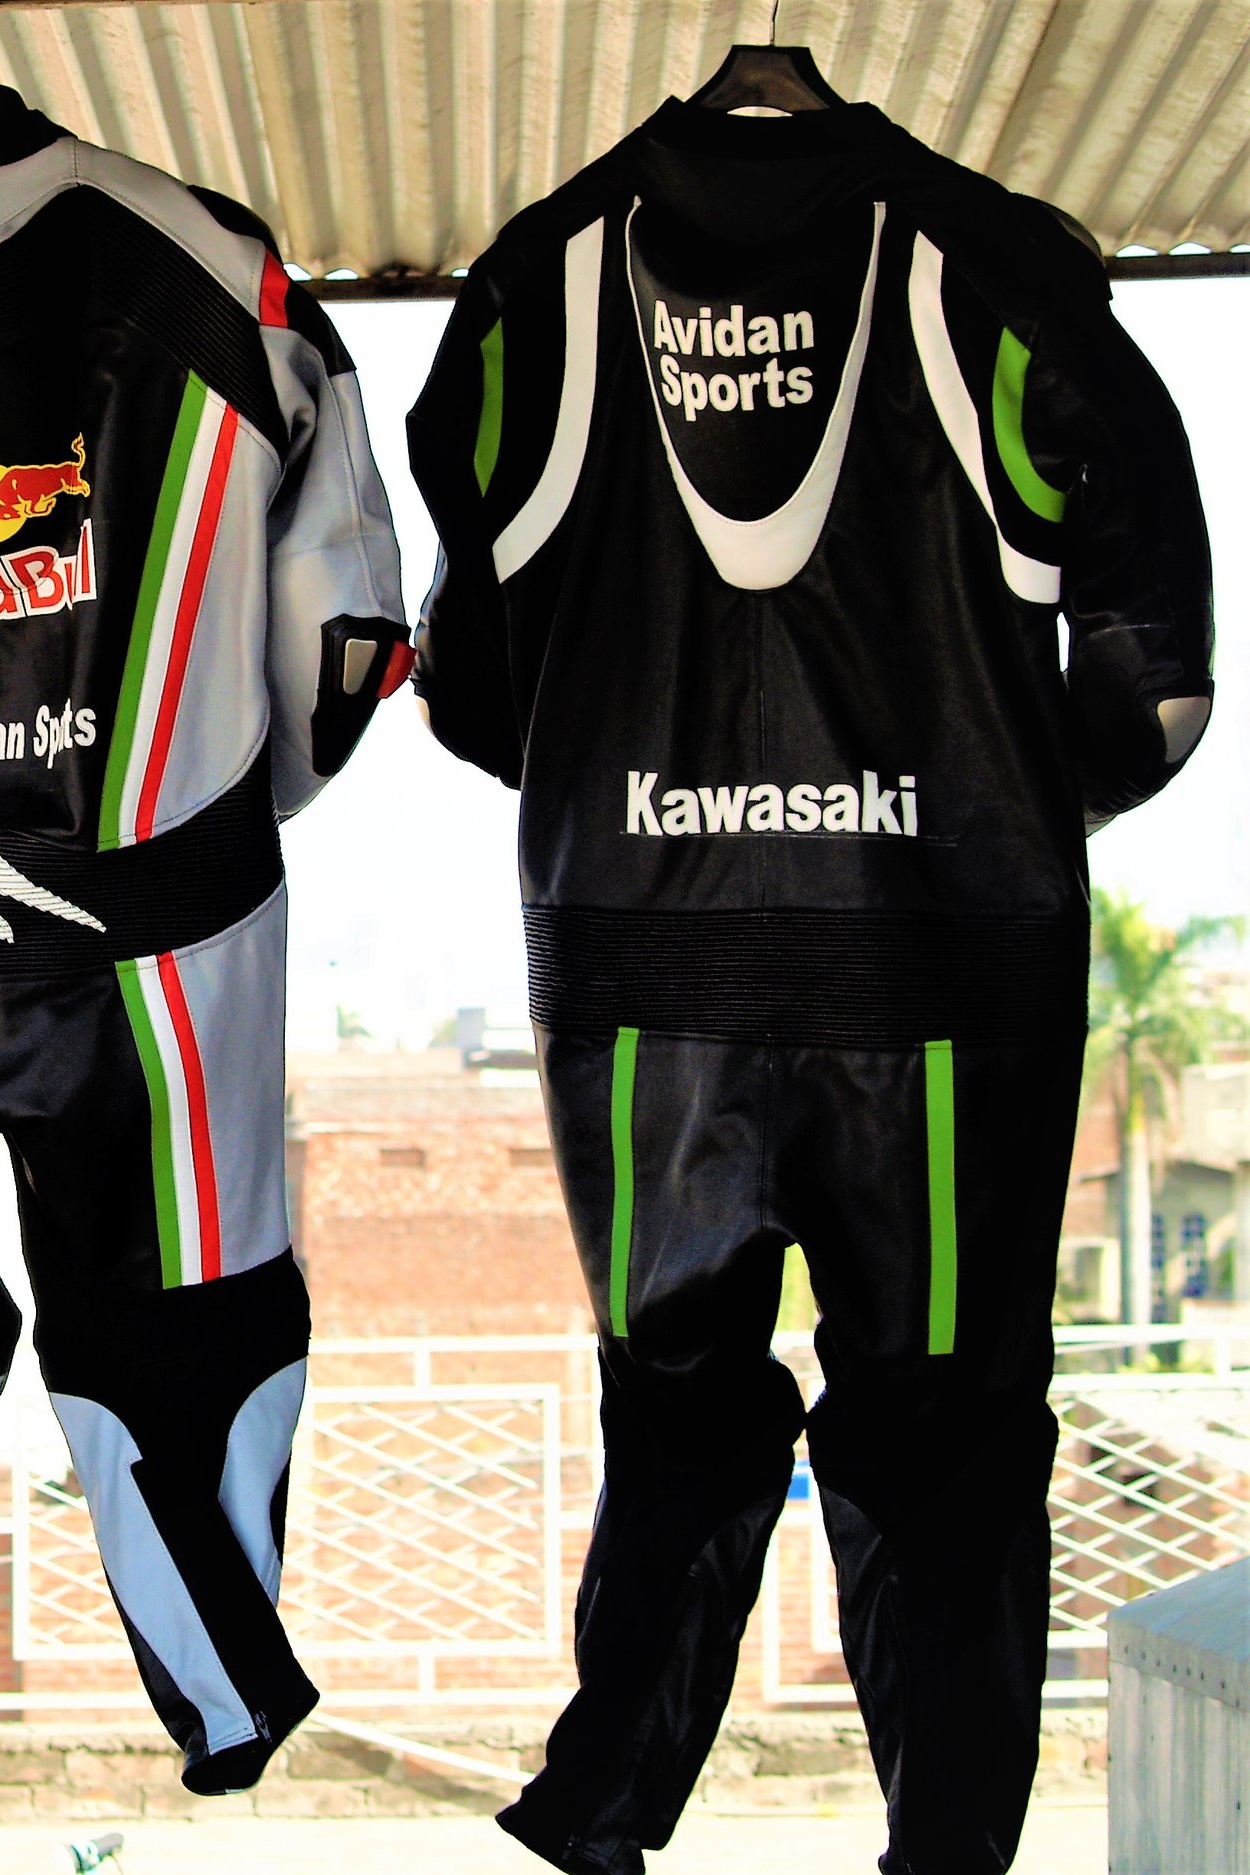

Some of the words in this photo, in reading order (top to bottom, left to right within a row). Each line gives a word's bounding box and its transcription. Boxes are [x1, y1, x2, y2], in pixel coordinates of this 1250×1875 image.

[654, 300, 814, 357] Avidan
[661, 355, 814, 422] Sports
[33, 698, 97, 769] Spts
[626, 770, 918, 837] Kawasaki
